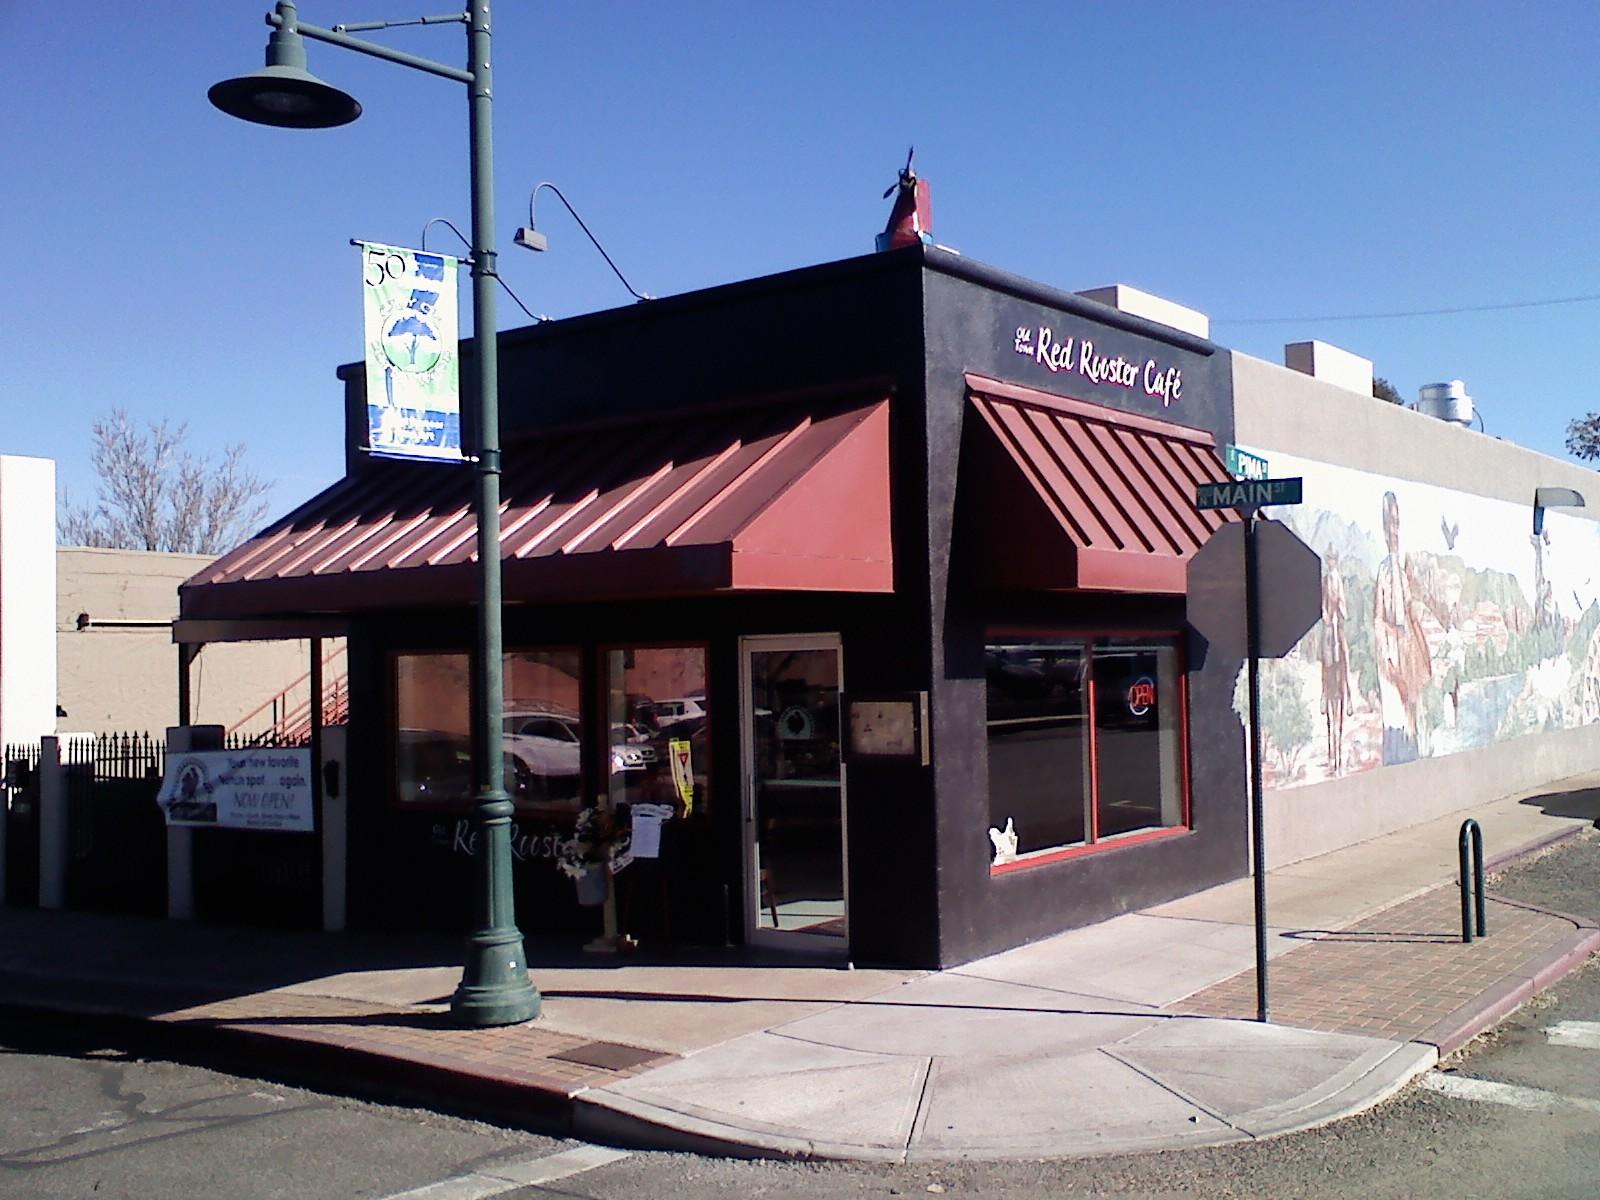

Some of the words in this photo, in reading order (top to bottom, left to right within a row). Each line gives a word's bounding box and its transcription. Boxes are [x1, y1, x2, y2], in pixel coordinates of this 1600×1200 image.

[365, 250, 406, 287] 50
[1015, 326, 1032, 342] Old
[1014, 338, 1035, 356] Town
[1036, 326, 1075, 372] Red
[1079, 340, 1139, 386] Rooster
[1143, 359, 1183, 408] Café
[1213, 483, 1272, 506] MAIN
[1273, 482, 1285, 493] ST
[267, 755, 300, 769] favorite
[246, 774, 265, 788] spot
[233, 791, 258, 808] NOW
[453, 819, 480, 856] Re
